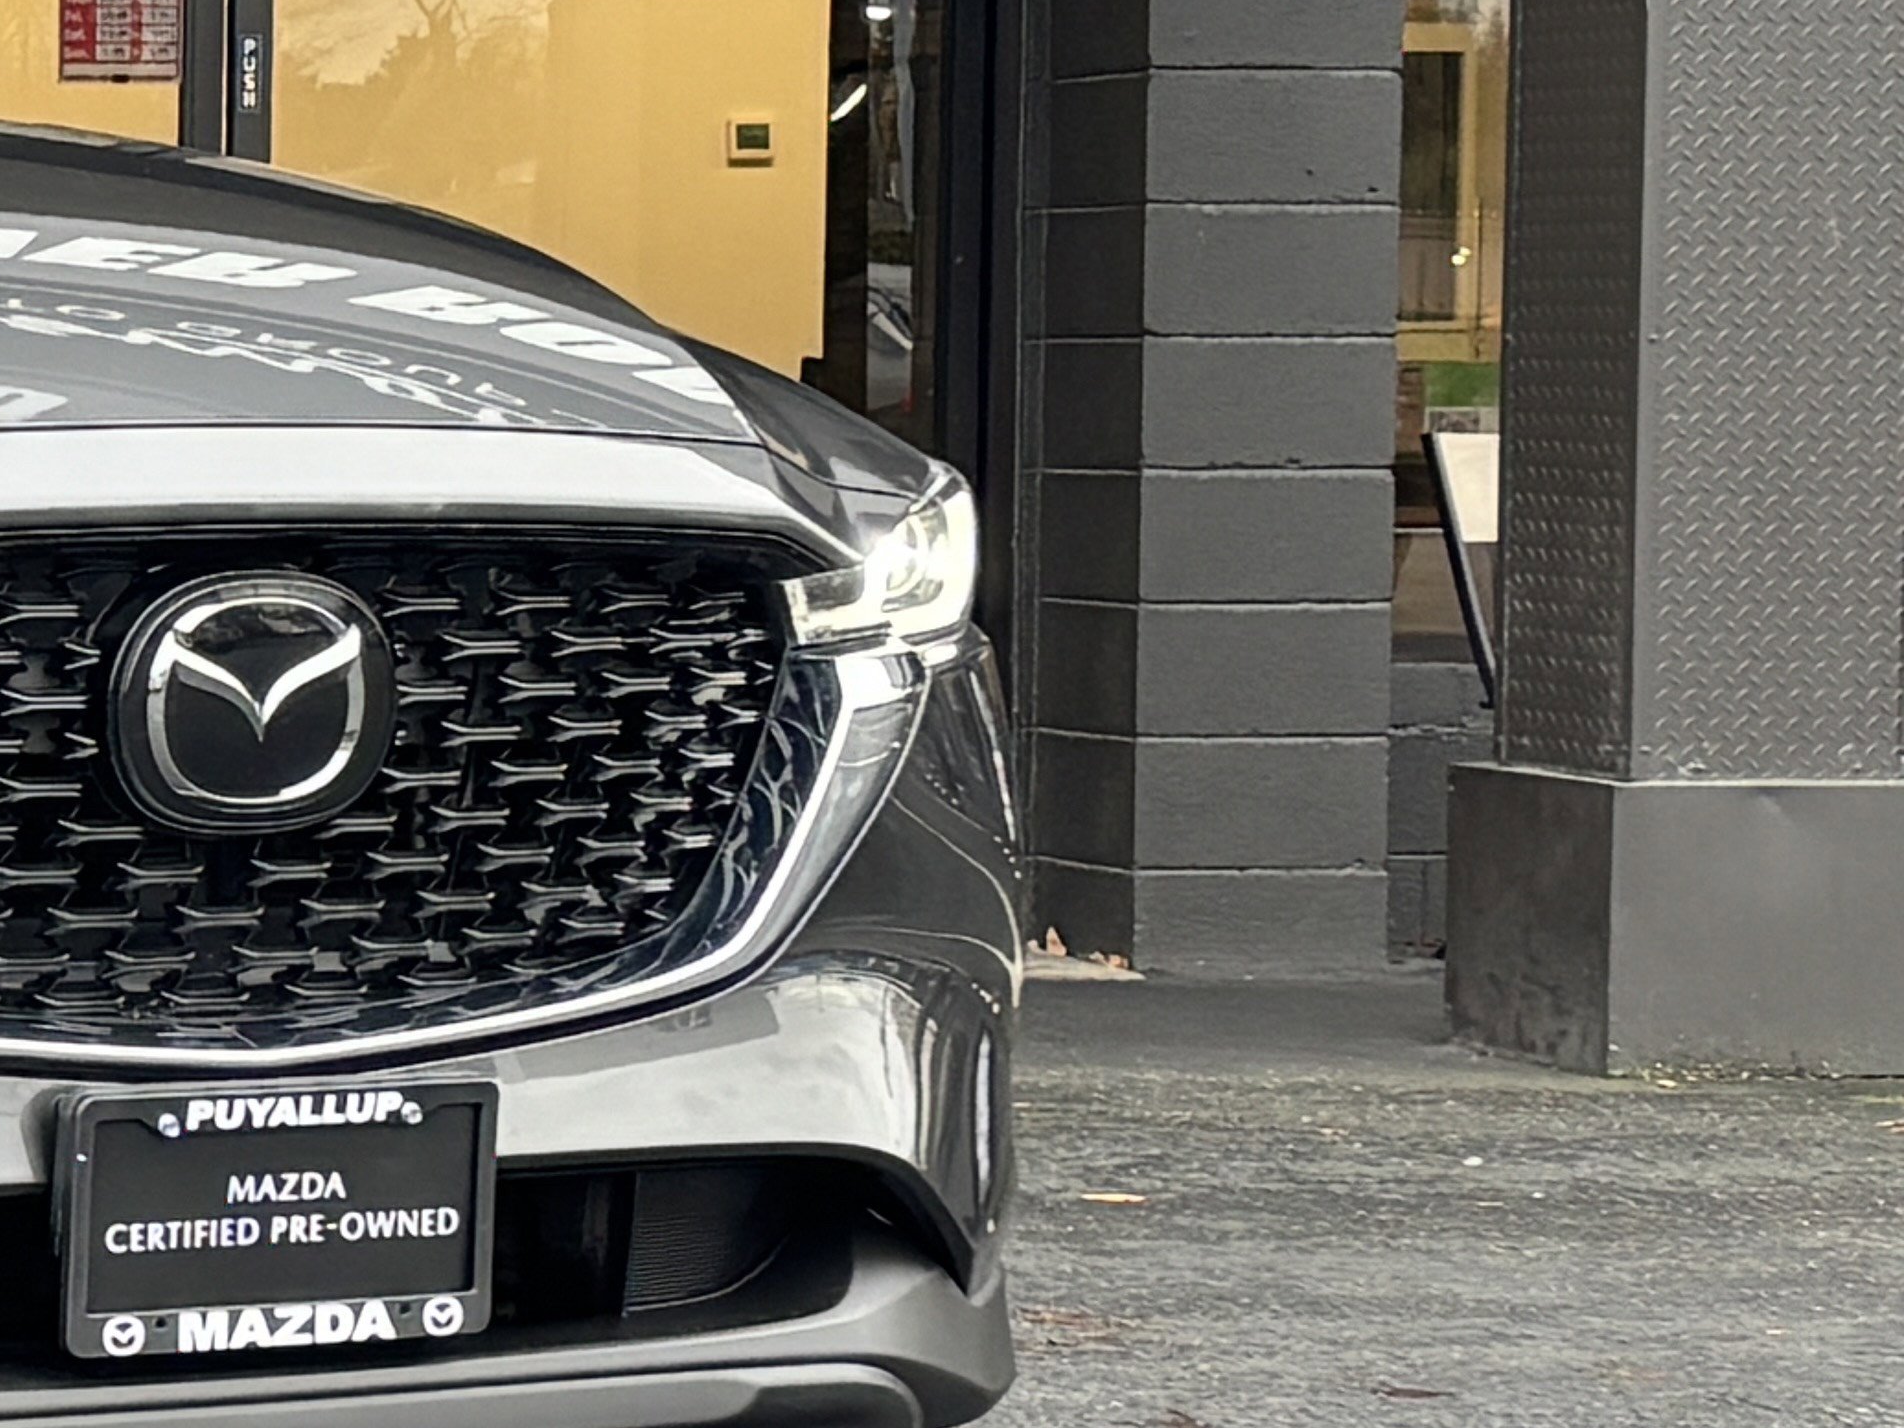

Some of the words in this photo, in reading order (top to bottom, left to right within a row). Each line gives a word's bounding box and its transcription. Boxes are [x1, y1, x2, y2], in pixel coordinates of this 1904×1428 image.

[242, 38, 256, 108] PUSH
[185, 1090, 401, 1132] PUYALLUP
[227, 1171, 346, 1204] MAZDA
[104, 1217, 260, 1254] CERTIFIED
[270, 1206, 460, 1245] PRE-OWNED
[177, 1298, 398, 1353] MAZDA
